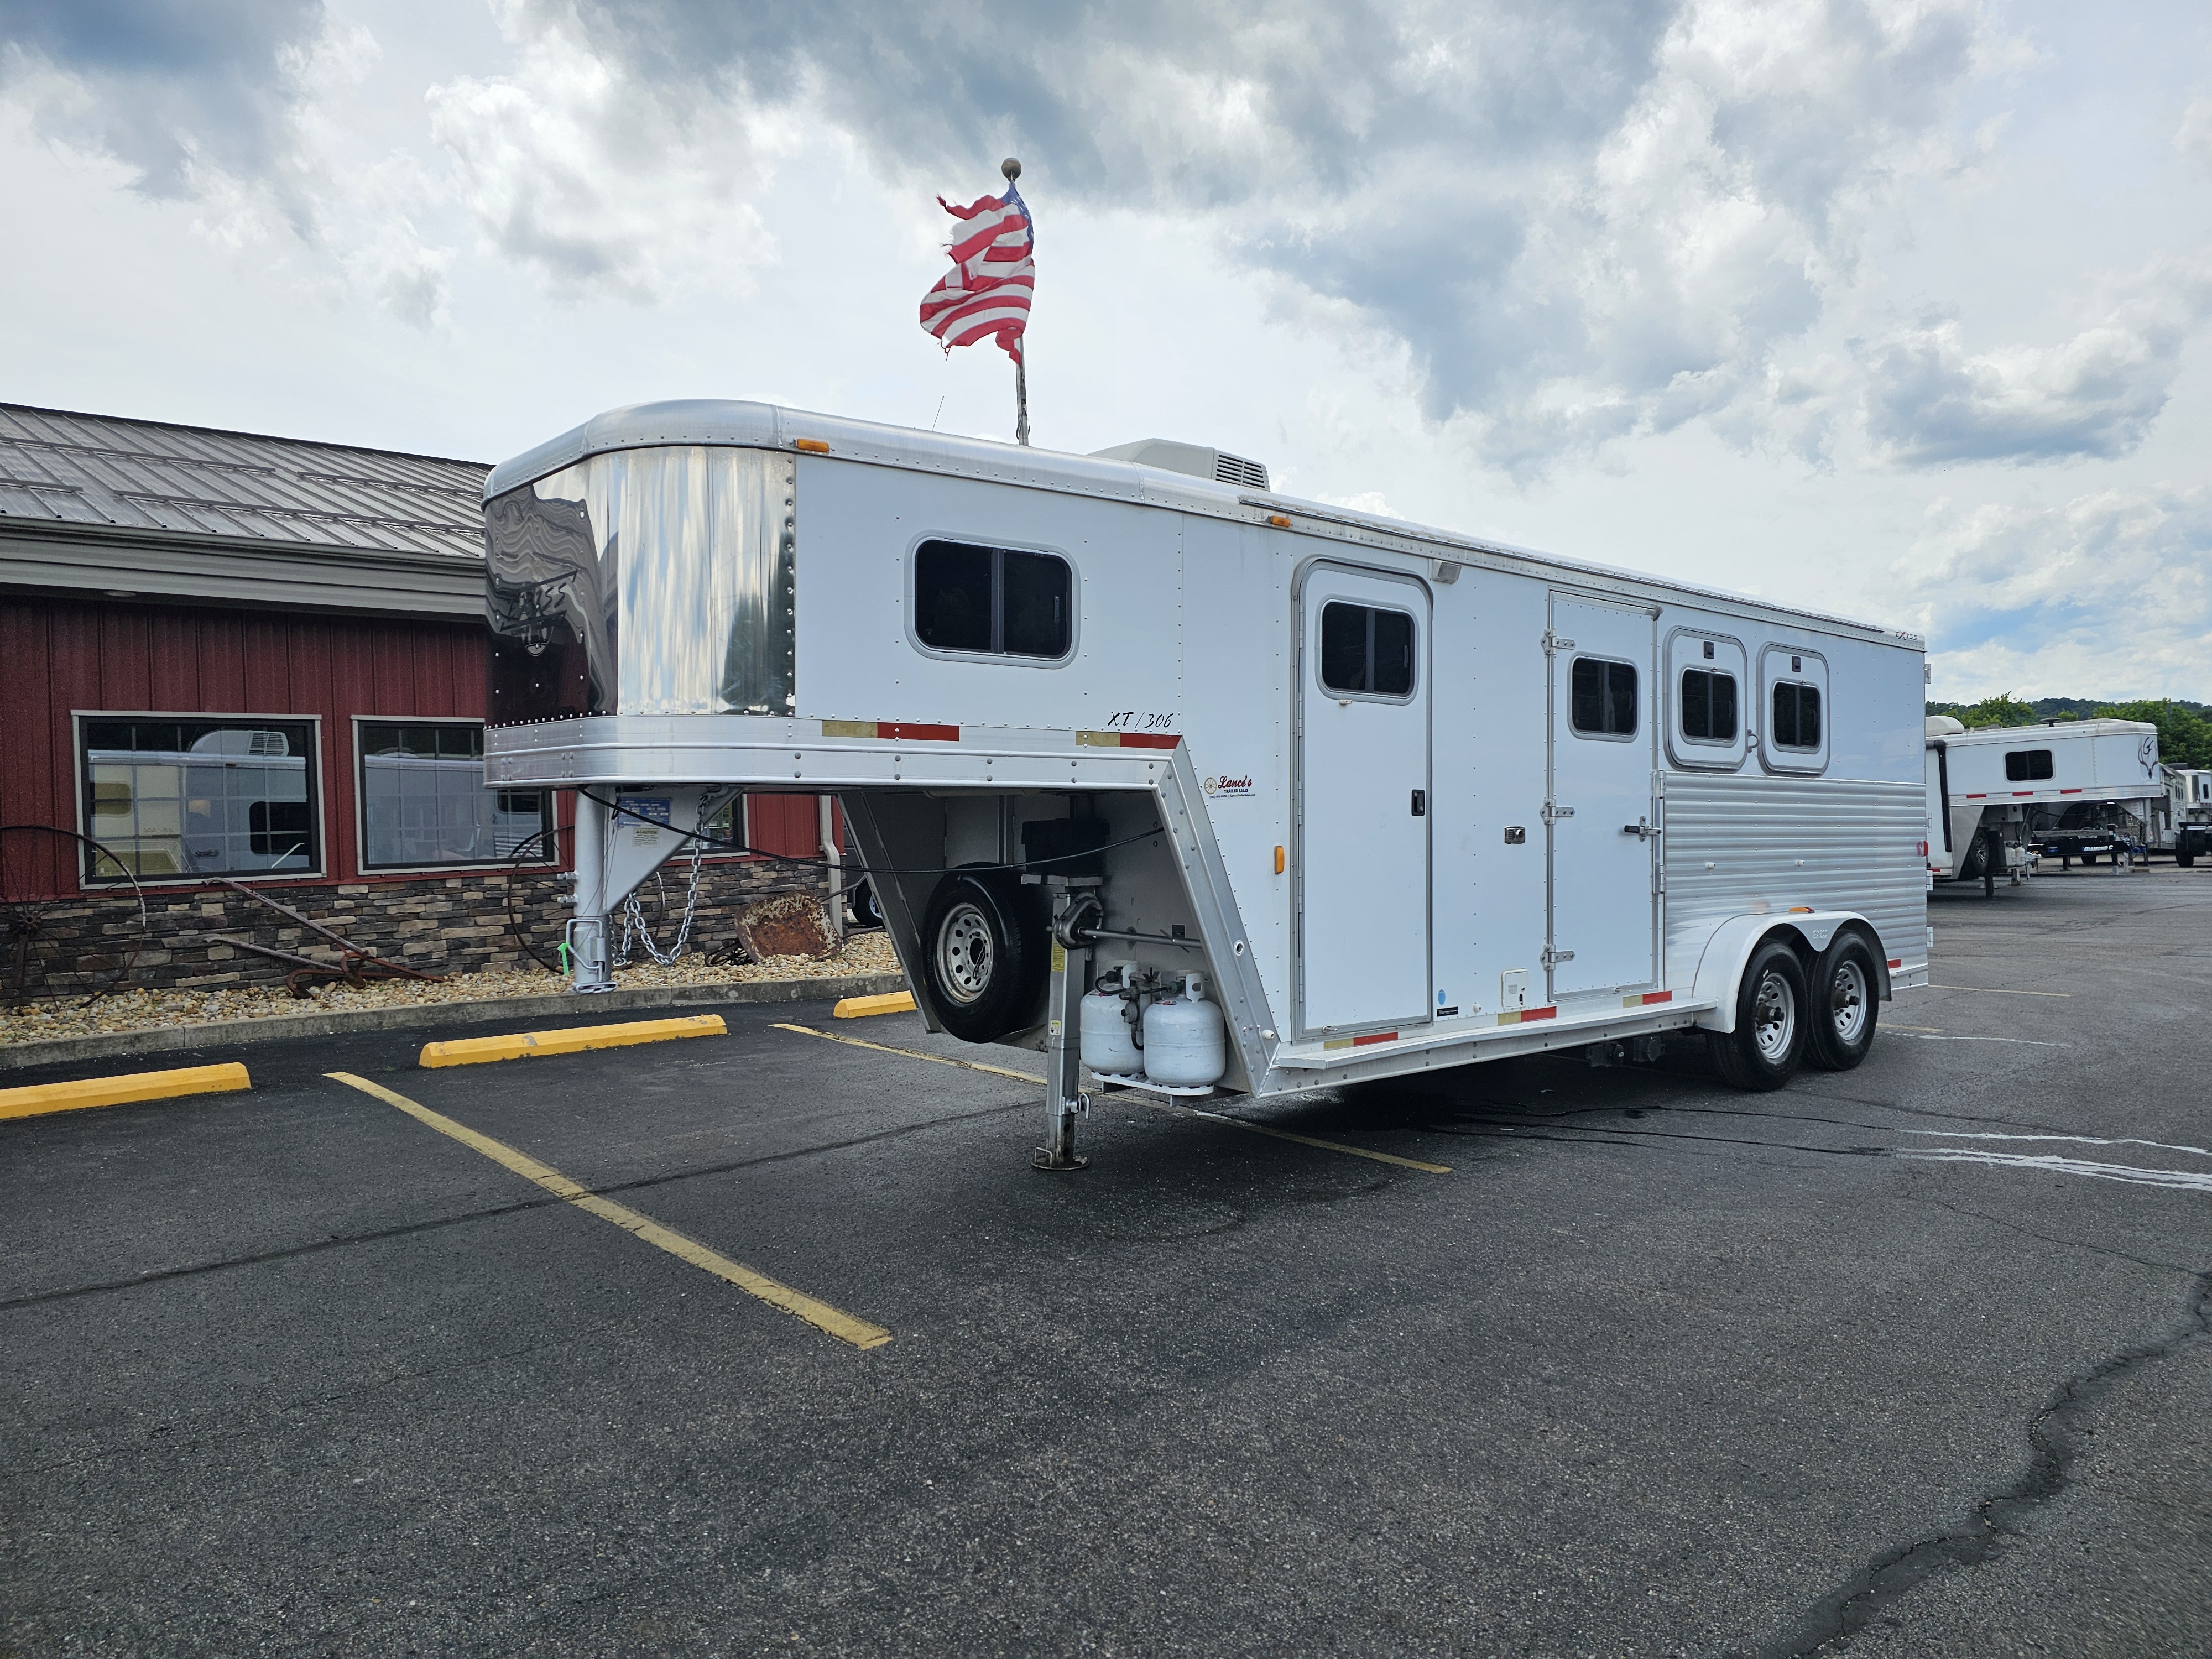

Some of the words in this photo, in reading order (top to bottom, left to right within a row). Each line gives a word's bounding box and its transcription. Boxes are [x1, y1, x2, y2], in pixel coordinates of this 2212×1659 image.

[1895, 629, 1917, 640] EXISS
[1107, 711, 1173, 729] XT/306
[1218, 775, 1252, 789] Lance's
